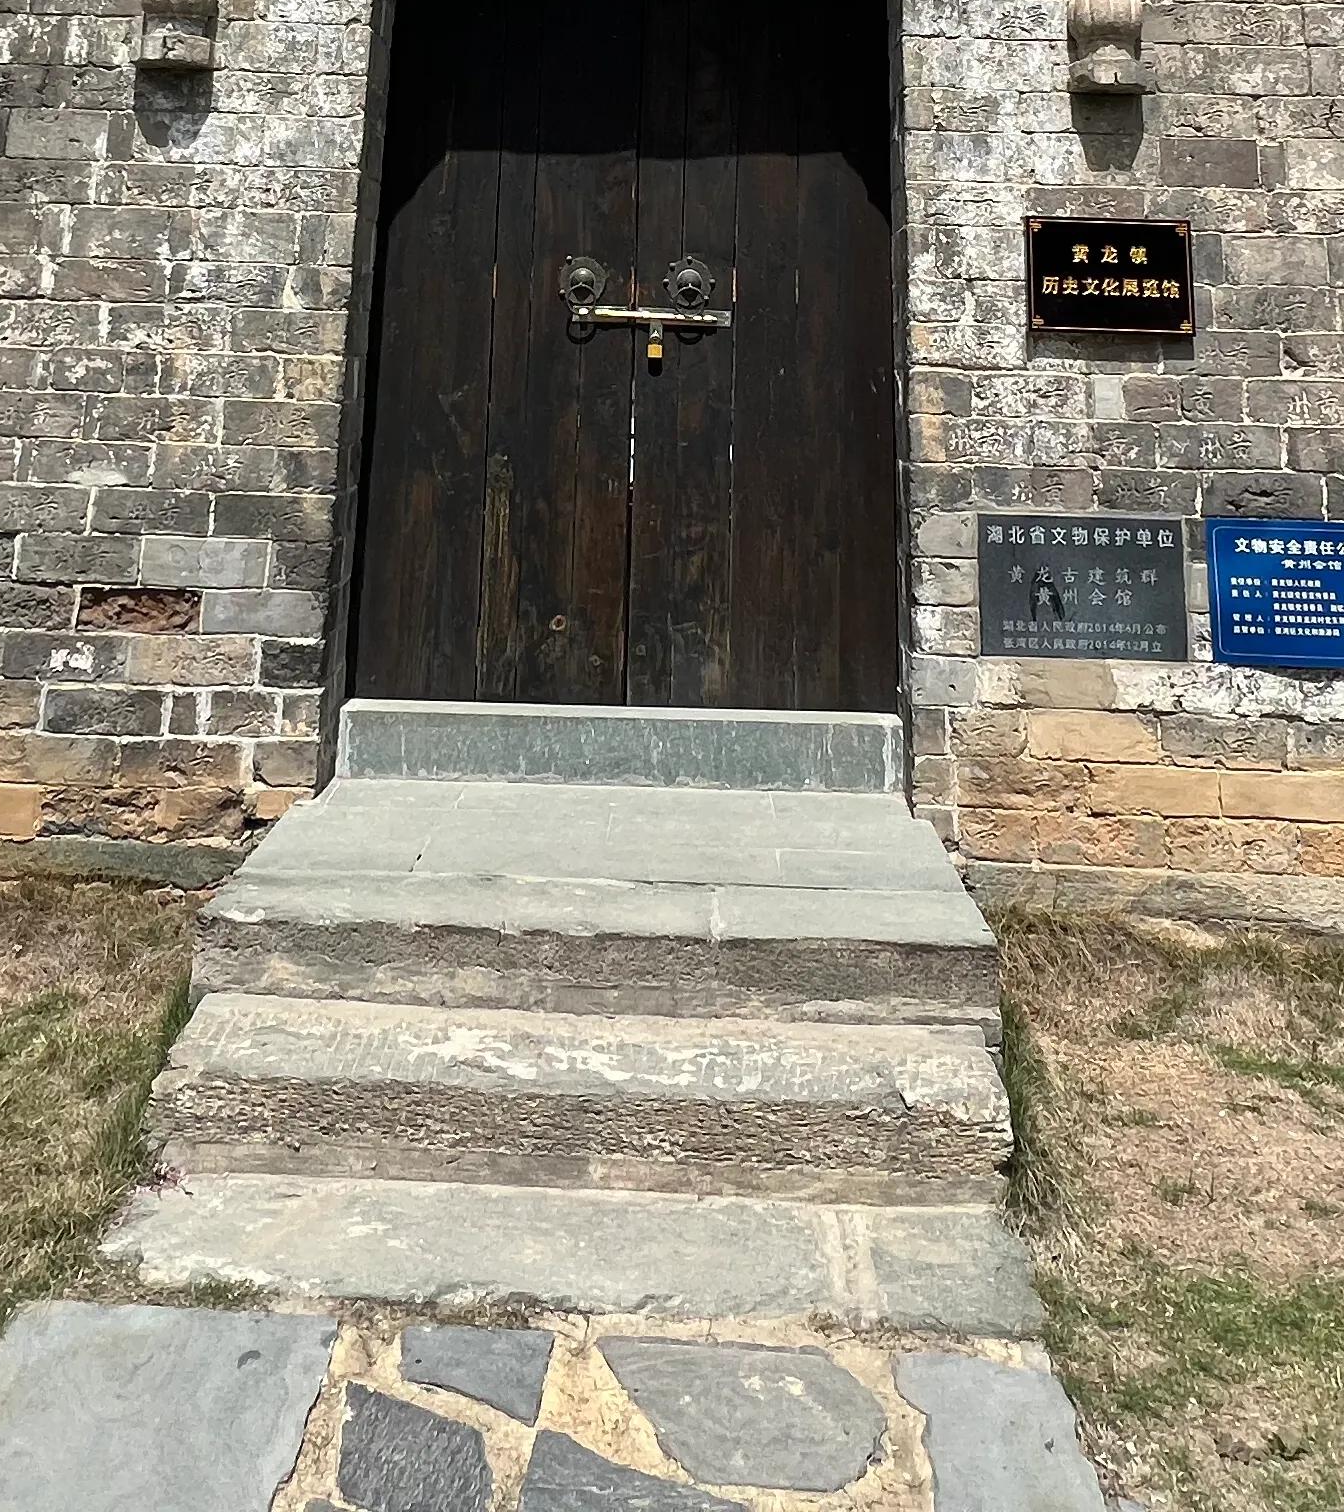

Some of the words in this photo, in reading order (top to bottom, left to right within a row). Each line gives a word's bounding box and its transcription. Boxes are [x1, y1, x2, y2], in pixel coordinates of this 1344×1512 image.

[1072, 243, 1148, 265] 黄龙镇
[1042, 275, 1181, 299] 历史文化展览馆
[986, 525, 1175, 548] 湖北省文物保护单位
[1008, 564, 1159, 586] 黄龙古建筑群
[1034, 587, 1133, 607] 黄州会馆
